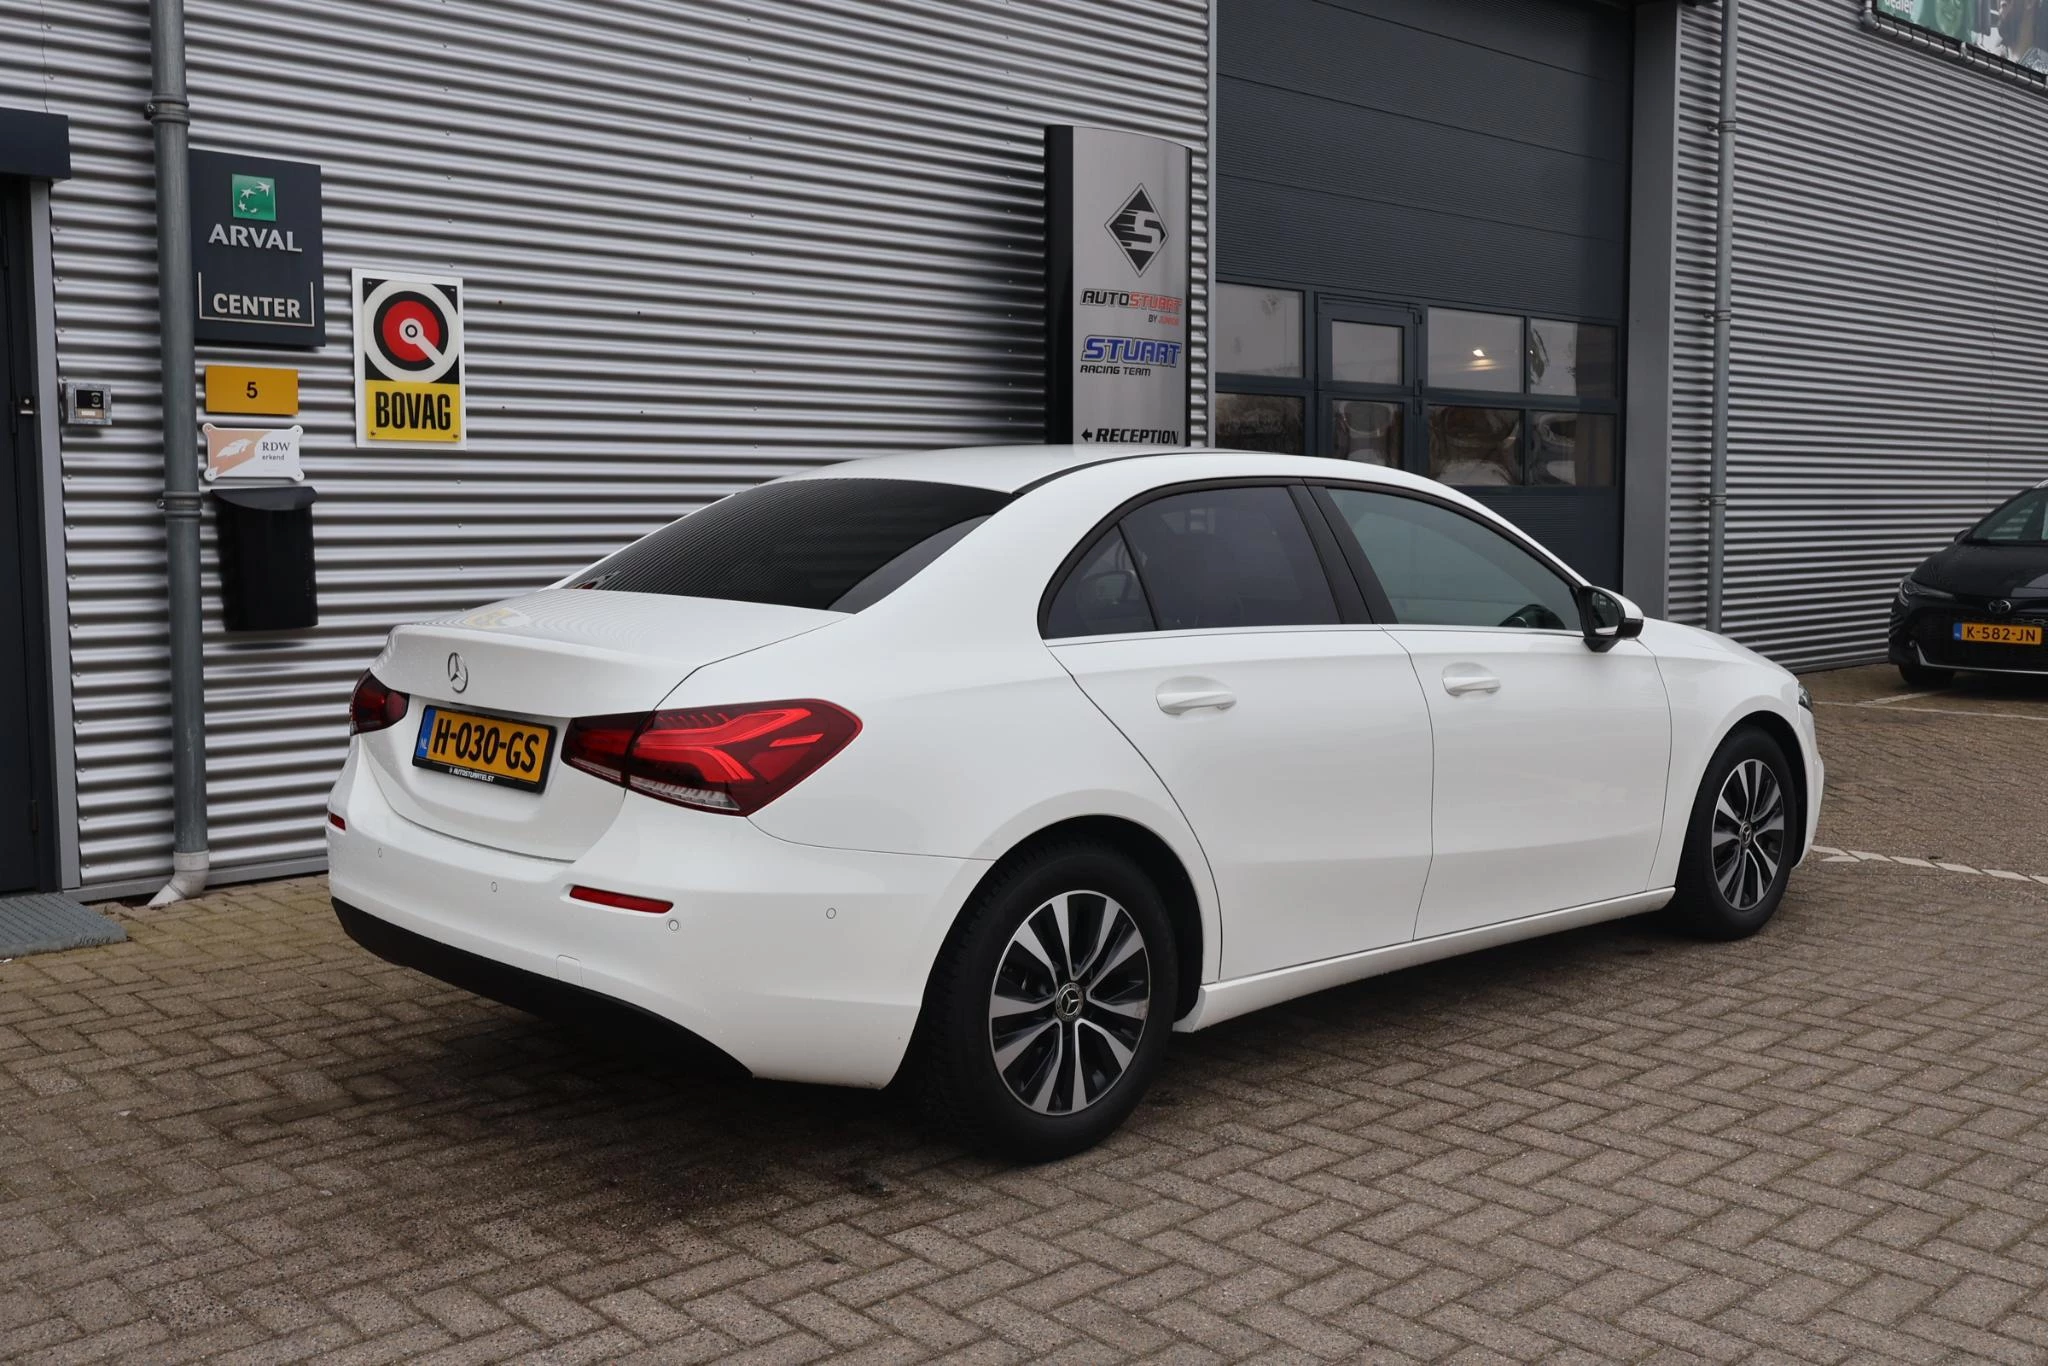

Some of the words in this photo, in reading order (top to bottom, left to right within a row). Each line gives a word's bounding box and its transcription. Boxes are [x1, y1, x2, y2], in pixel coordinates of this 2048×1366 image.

[208, 223, 303, 252] ARVAL
[213, 293, 300, 319] CENTER
[1148, 314, 1158, 323] BY
[1081, 335, 1182, 368] STUART
[1080, 364, 1120, 375] RACING
[1123, 366, 1151, 377] TEAM
[246, 381, 258, 399] 5
[375, 391, 451, 431] BOVAG
[1095, 428, 1179, 445] RECEPTION
[262, 442, 291, 452] RDW
[1967, 626, 2035, 642] K-582-JN
[433, 718, 539, 773] H-030-GS
